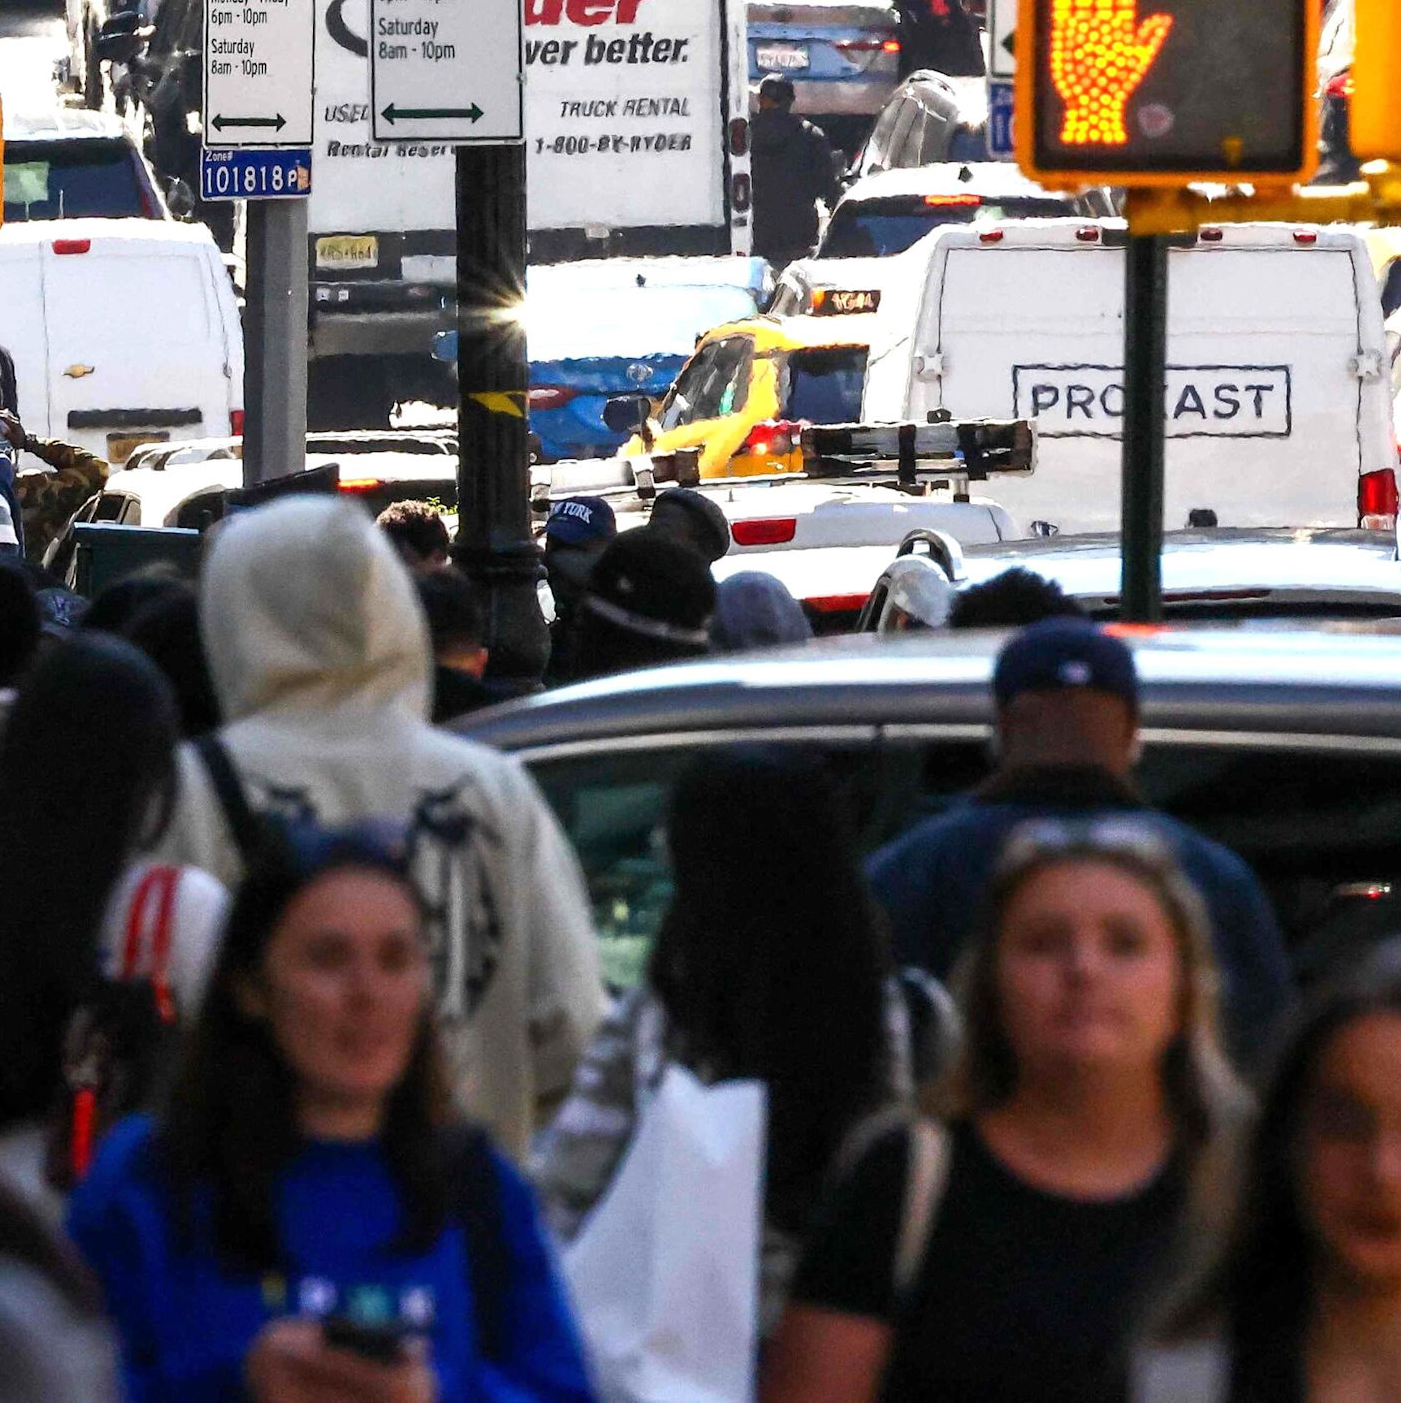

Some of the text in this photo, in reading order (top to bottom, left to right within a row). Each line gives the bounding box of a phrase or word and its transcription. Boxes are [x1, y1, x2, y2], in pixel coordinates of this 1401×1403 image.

[211, 8, 268, 25] 6pm 10pm
[378, 16, 439, 36] Saturday
[211, 38, 255, 58] Saturday
[379, 43, 456, 62] 8am 10pm
[525, 32, 690, 66] ver better.
[211, 59, 267, 77] 8am 10pm
[559, 97, 690, 118] TRUCK RENTAL
[206, 164, 283, 194] 101818
[1032, 383, 1274, 421] PROAST
[563, 501, 594, 525] YORK
